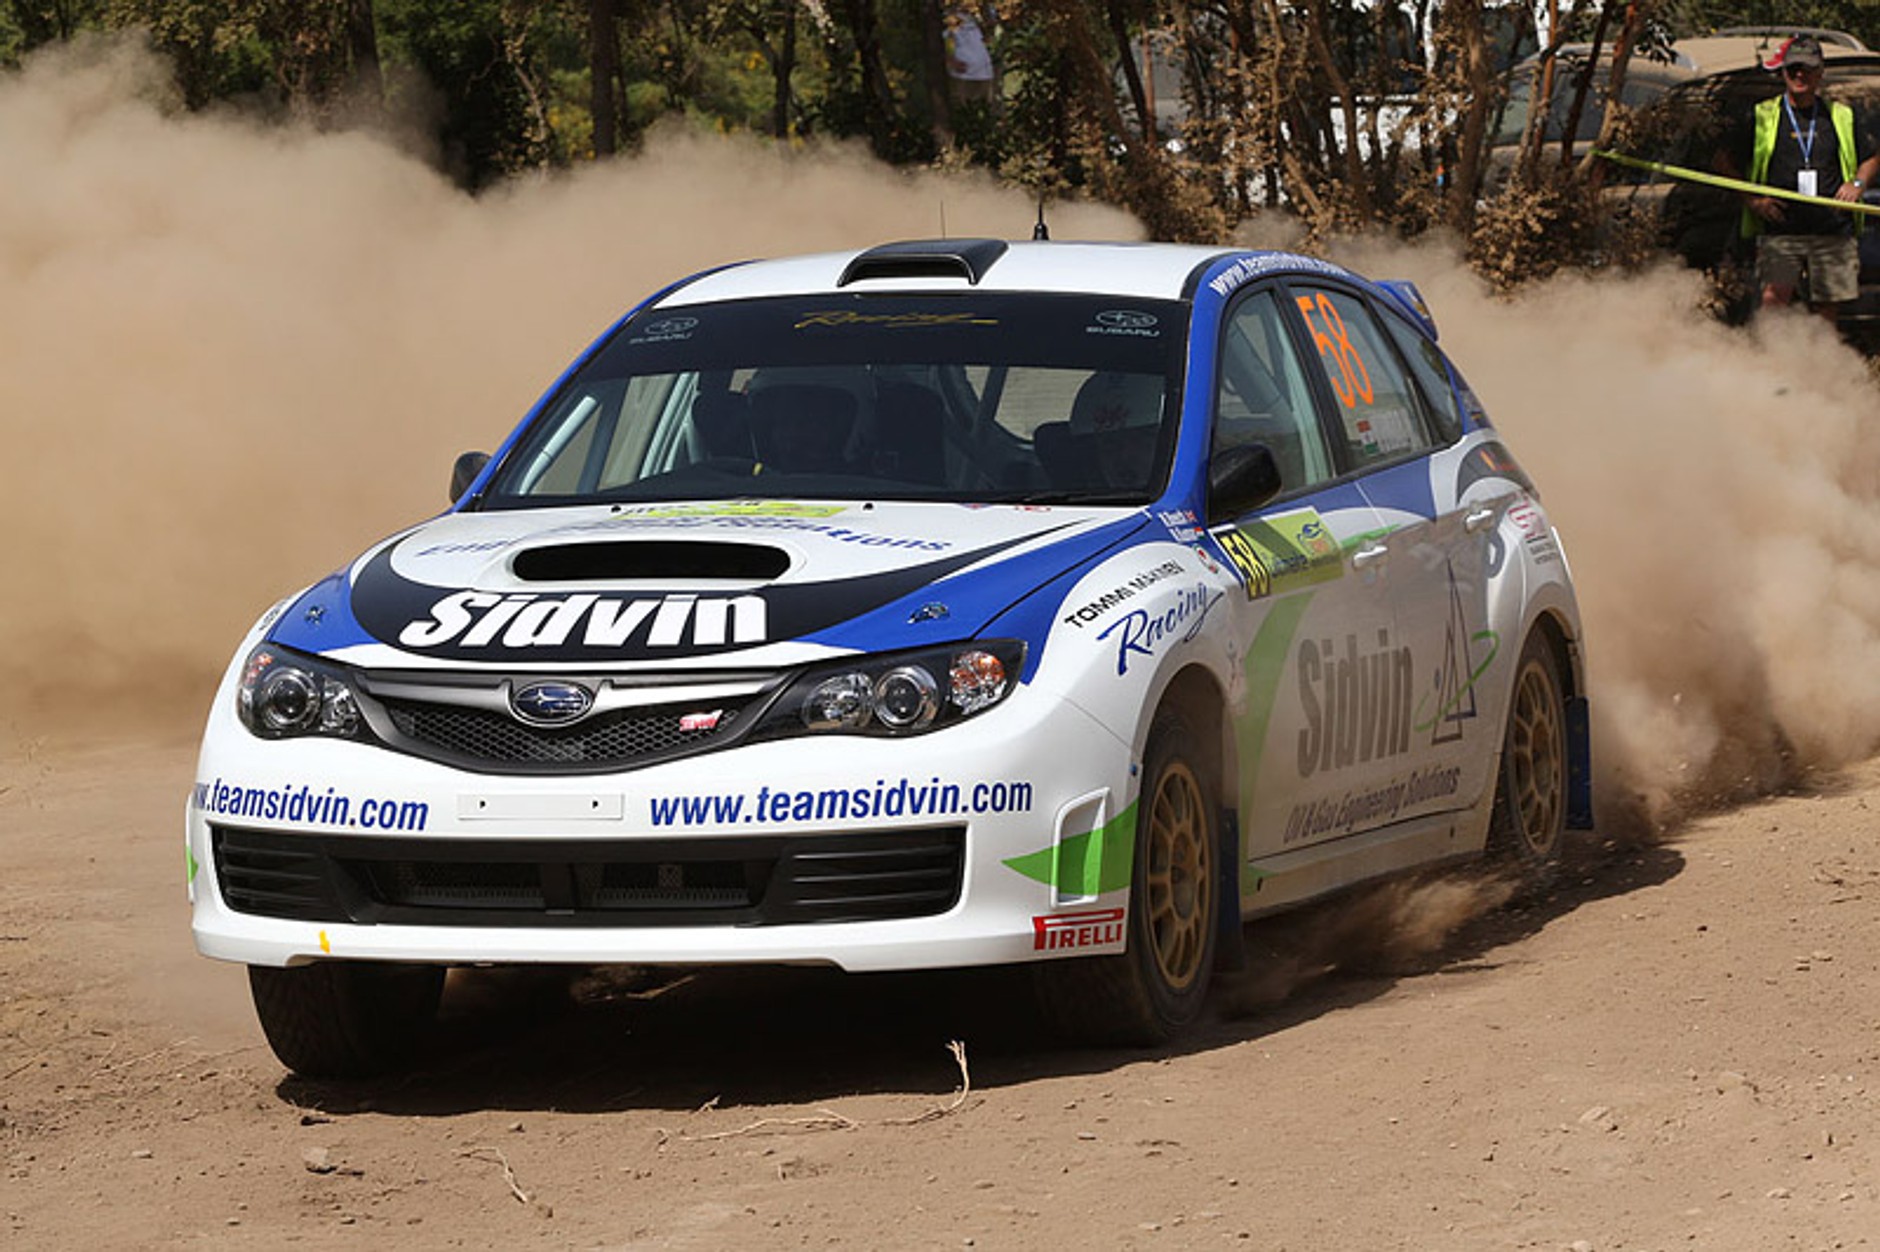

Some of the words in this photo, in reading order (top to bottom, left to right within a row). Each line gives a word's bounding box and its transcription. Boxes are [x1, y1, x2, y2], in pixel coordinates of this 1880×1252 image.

[1296, 292, 1374, 409] 58
[398, 588, 768, 648] Sidvin
[1096, 582, 1225, 676] Racing
[1297, 628, 1414, 778] Sidvin
[649, 776, 1033, 826] www.teamsidvin.com
[1032, 907, 1124, 951] PIRELLI
